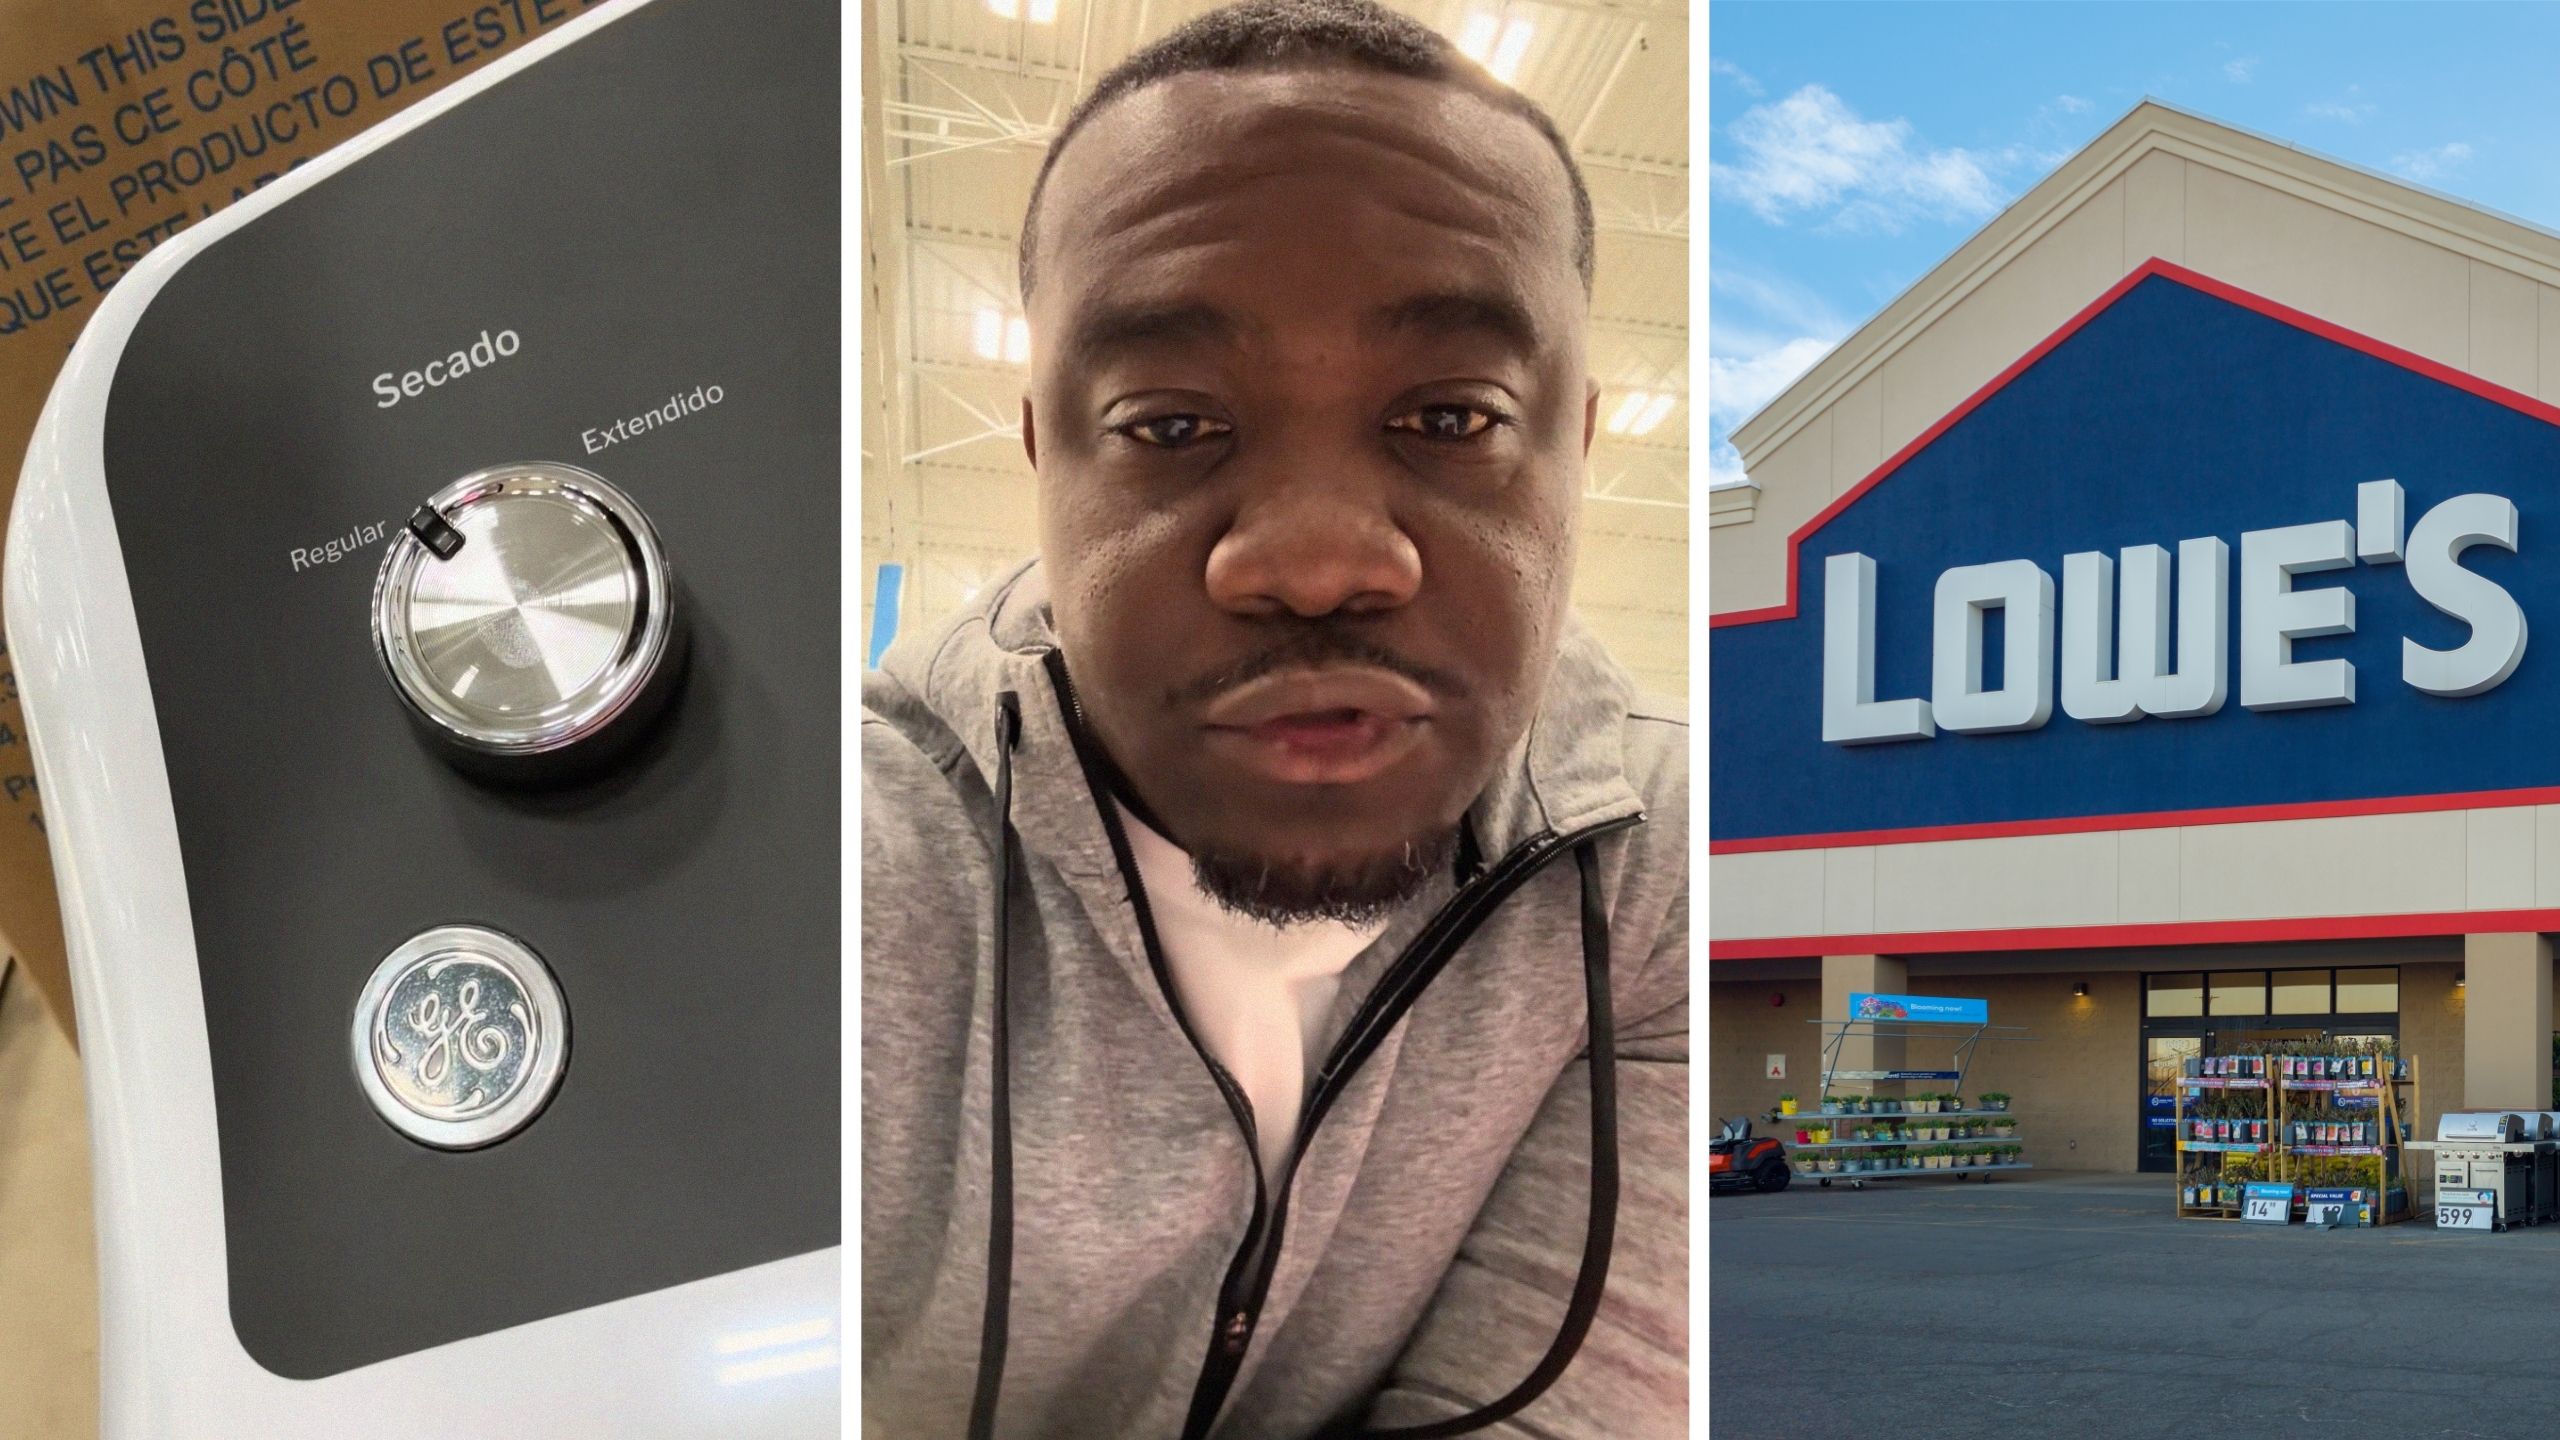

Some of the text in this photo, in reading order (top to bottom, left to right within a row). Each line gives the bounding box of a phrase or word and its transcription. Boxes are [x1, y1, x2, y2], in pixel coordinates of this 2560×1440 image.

[0, 64, 79, 142] WN
[77, 17, 186, 92] THIS
[14, 16, 318, 194] PAS CE CÔTÉ
[47, 195, 110, 245] EL
[109, 74, 358, 217] PRODUCTO
[366, 36, 436, 99] DE
[0, 267, 83, 335] QUE
[372, 329, 521, 409] Secado
[581, 384, 725, 455] Extendido
[289, 519, 387, 573] Regular
[1822, 478, 2529, 747] LOWE'S
[1910, 1003, 1944, 1013] Blooming
[2251, 1201, 2268, 1217] 14
[2439, 1207, 2473, 1225] 599
